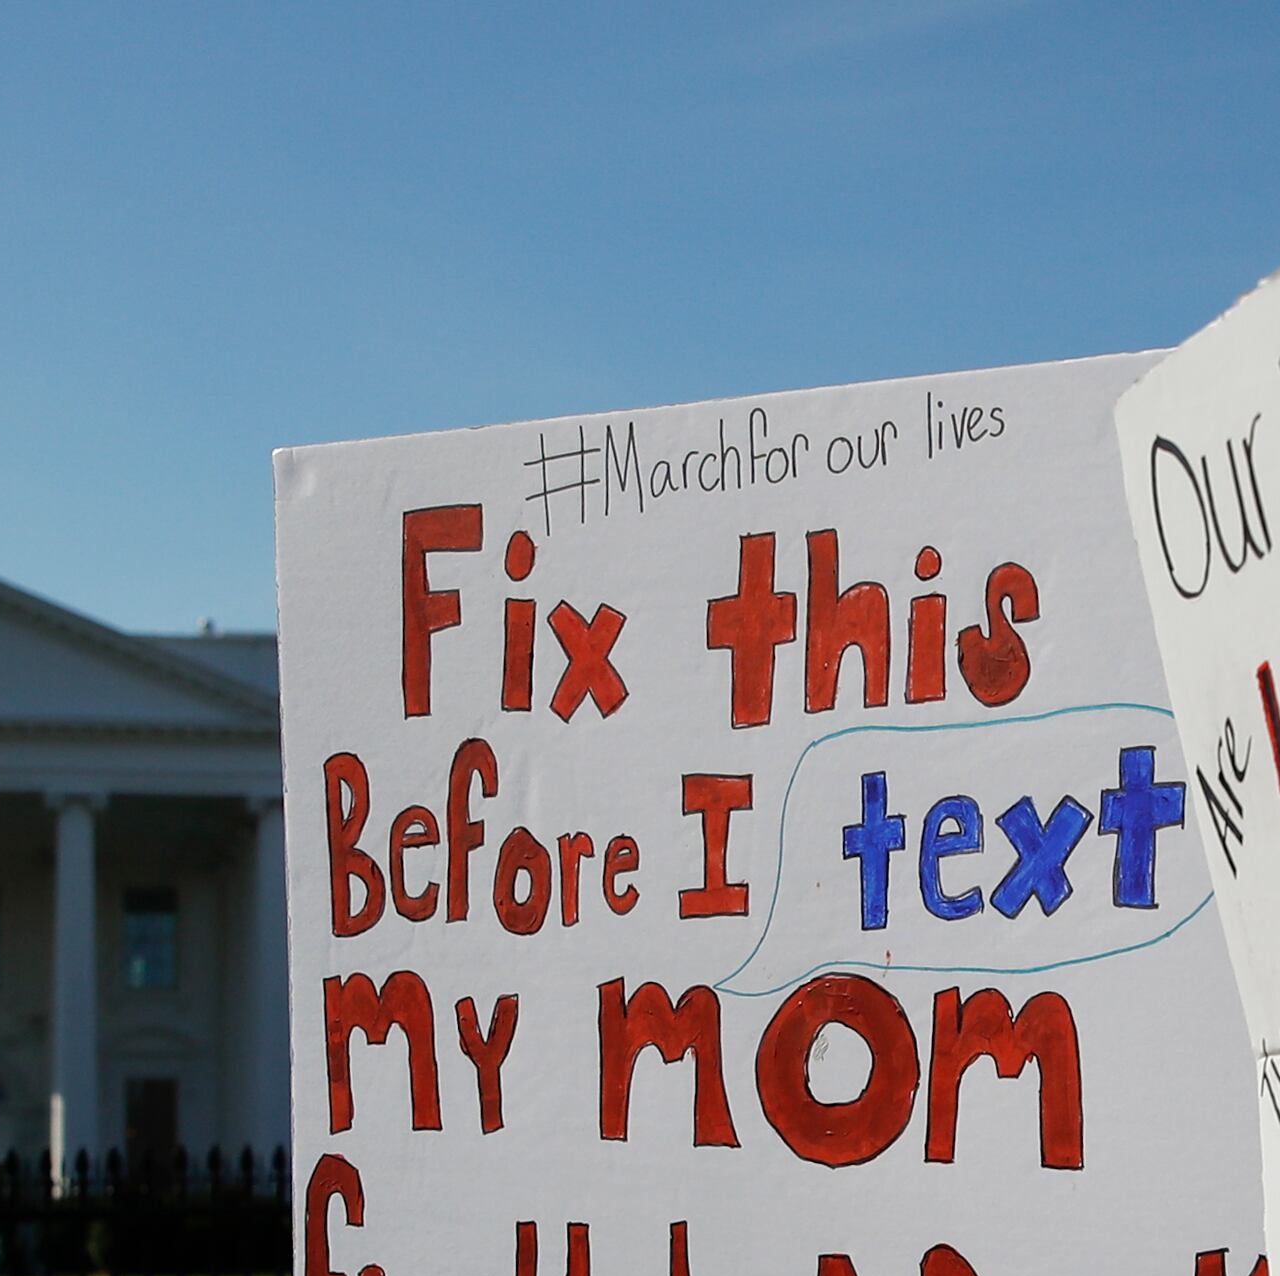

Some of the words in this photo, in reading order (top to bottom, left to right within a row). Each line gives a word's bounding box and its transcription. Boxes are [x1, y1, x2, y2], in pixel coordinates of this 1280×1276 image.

[827, 425, 898, 475] our
[926, 391, 1006, 461] lives
[1150, 413, 1272, 599] Our
[402, 503, 628, 722] Fix
[706, 529, 1040, 728] this
[323, 738, 640, 938] Before
[677, 772, 754, 919] I
[842, 746, 1186, 930] text
[1194, 716, 1252, 878] Are
